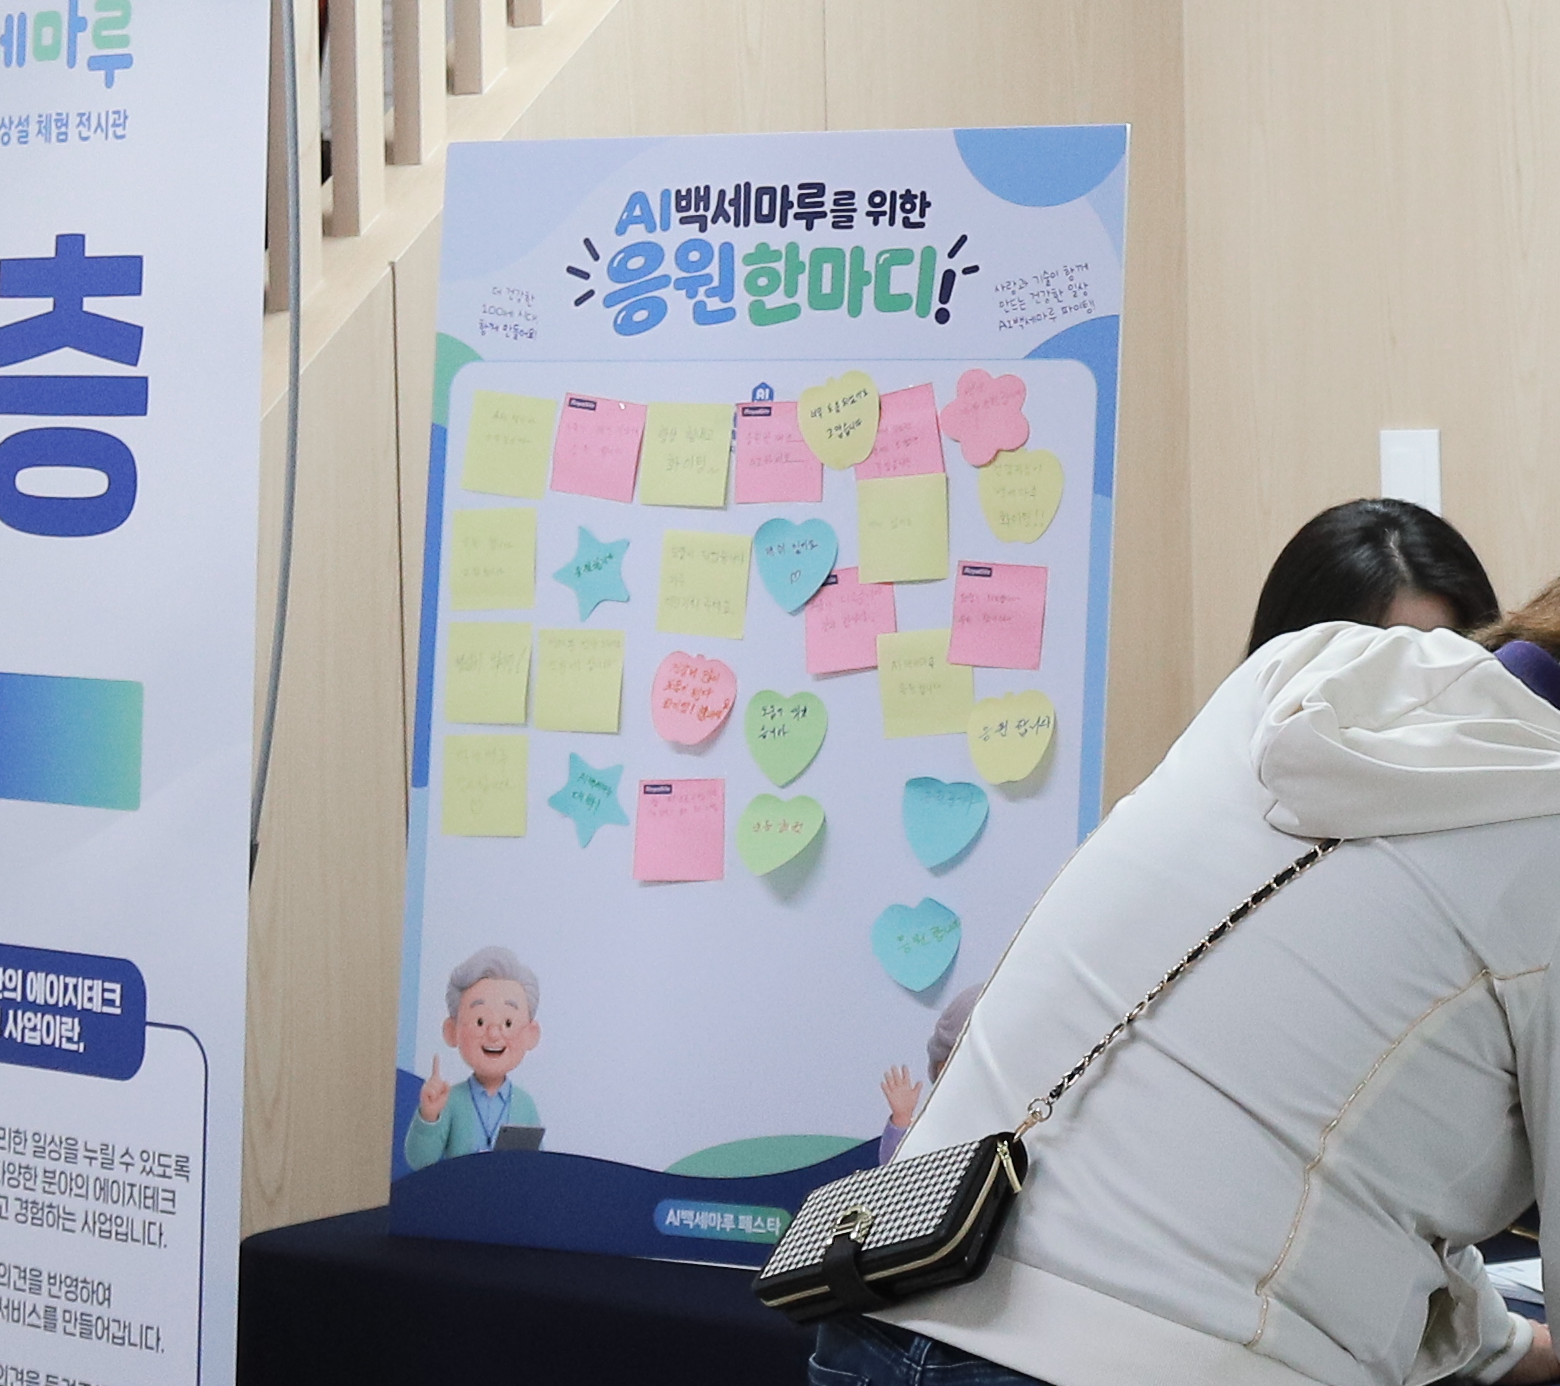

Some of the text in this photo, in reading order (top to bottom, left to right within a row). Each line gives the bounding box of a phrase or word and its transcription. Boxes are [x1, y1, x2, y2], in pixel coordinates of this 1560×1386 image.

[35, 111, 70, 146] 체험
[75, 108, 129, 143] 전시관
[615, 182, 932, 234] AI백세마루를 위한
[603, 237, 957, 336] 응원 한마디!
[1032, 270, 1059, 286] 기술이
[1063, 263, 1088, 281] 함께
[999, 282, 1088, 313] 만드는 건강한 일상
[26, 971, 122, 1015] 에이지테크
[3, 1011, 86, 1053] 사업이란,
[31, 1130, 79, 1165] 일상을
[82, 1139, 116, 1169] 누릴
[118, 1147, 134, 1174] 수
[139, 1150, 191, 1184] 있도록
[666, 1208, 781, 1236] AI백세마루 페스타
